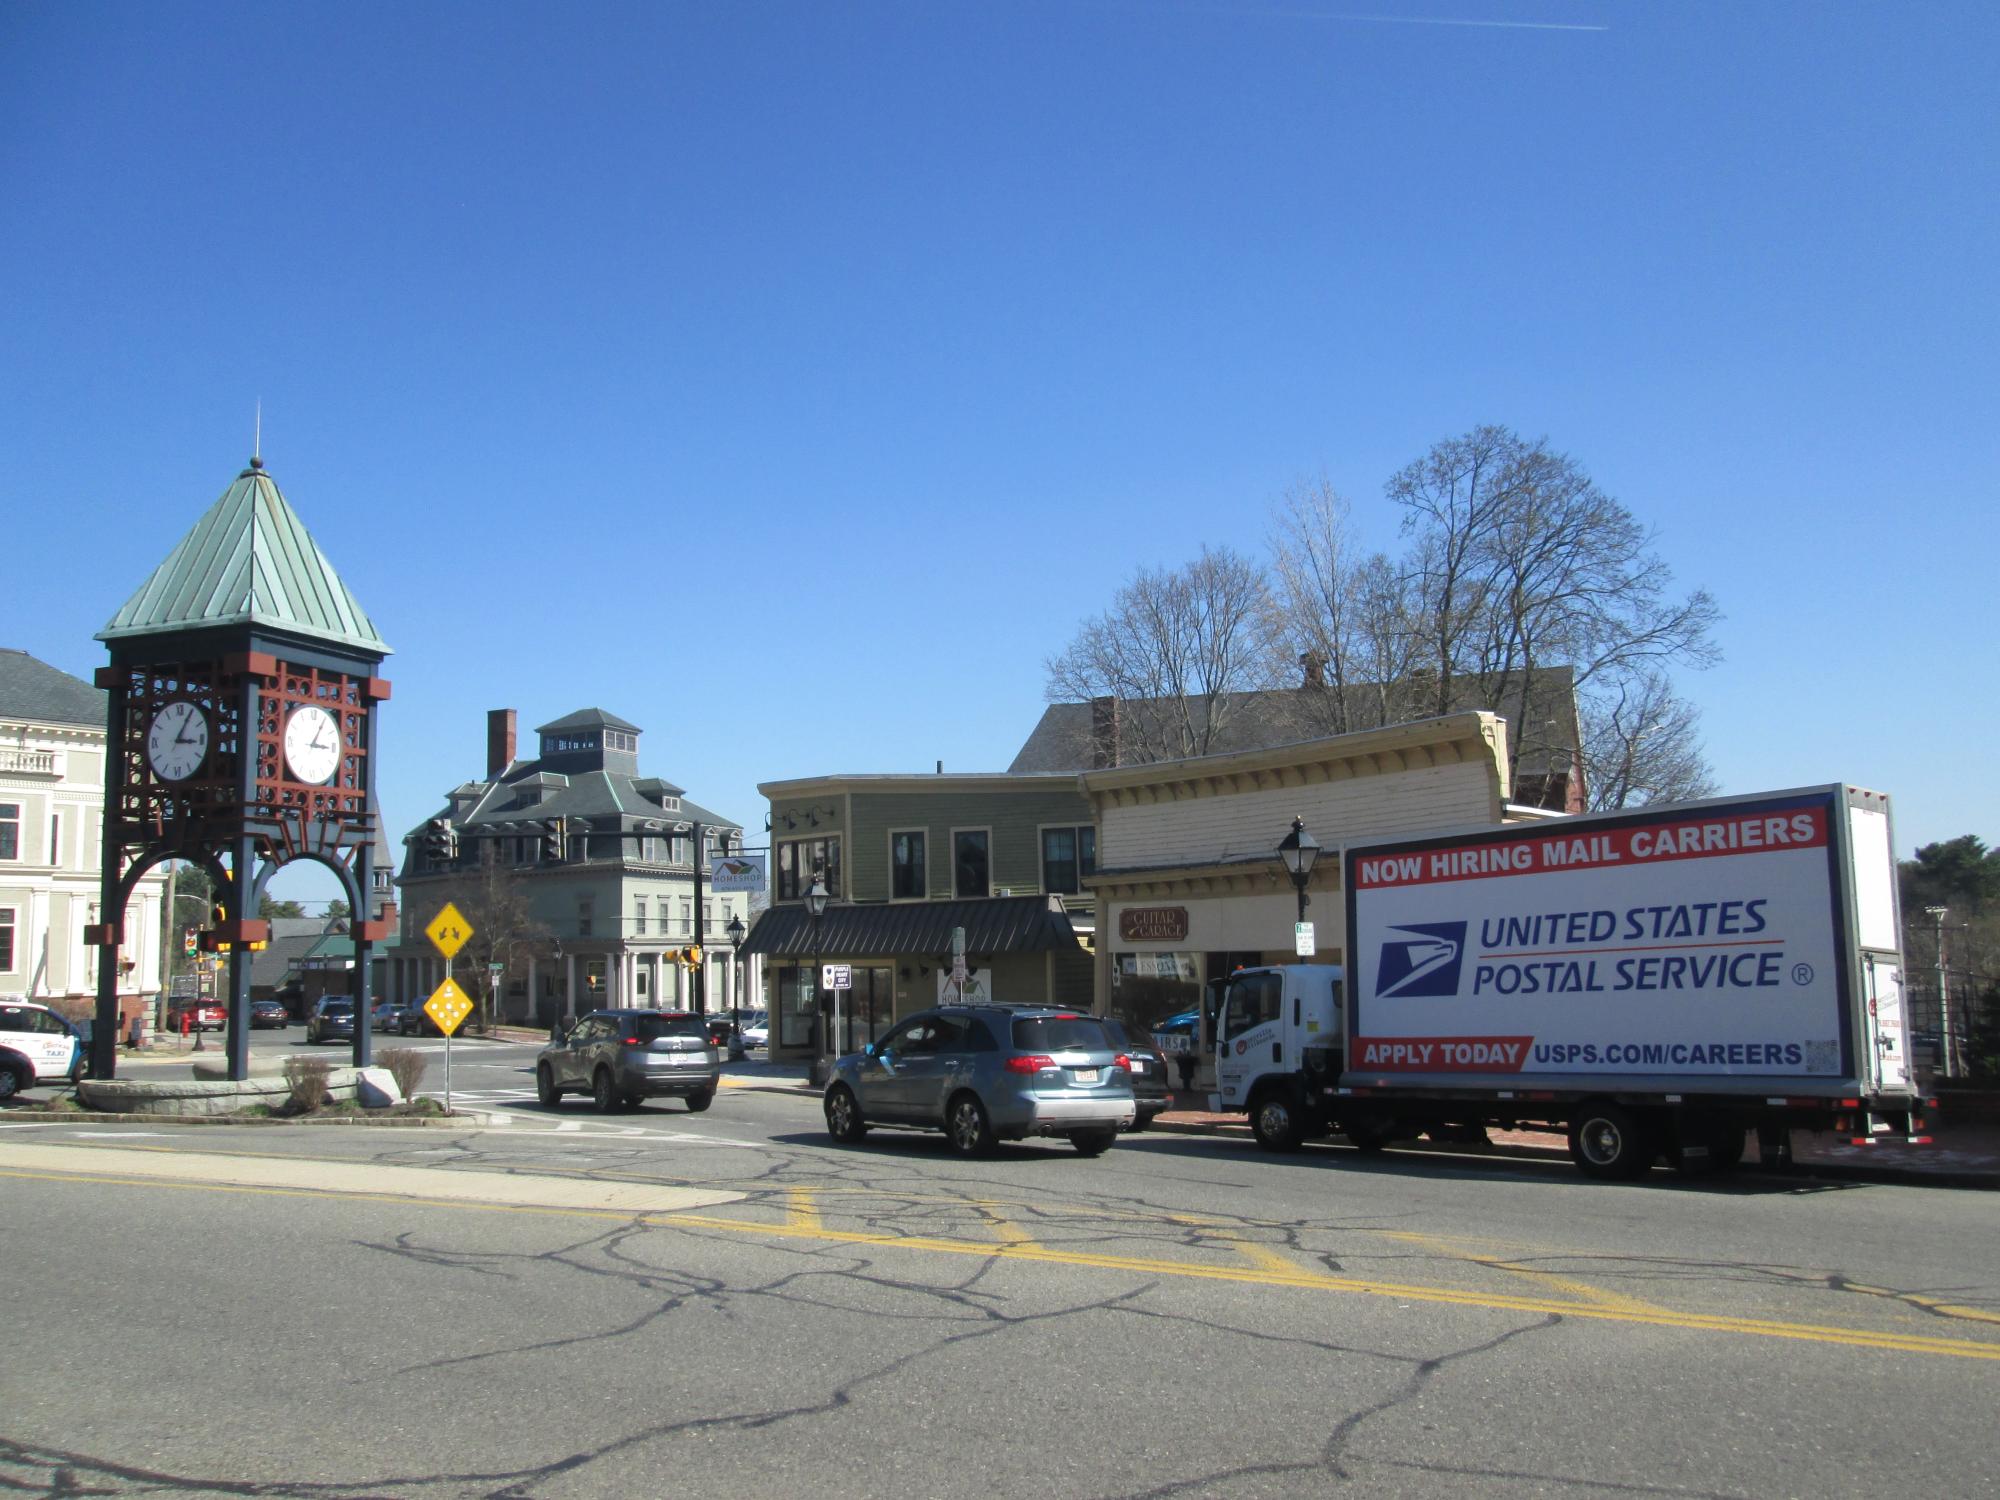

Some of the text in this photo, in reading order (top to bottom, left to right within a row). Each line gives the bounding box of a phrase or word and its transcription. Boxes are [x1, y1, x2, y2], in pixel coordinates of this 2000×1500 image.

[1362, 814, 1815, 884] NOW HIRING MAIL CARRIERS
[714, 873, 762, 883] HOMESHOP
[1133, 911, 1176, 925] GUITAR
[1481, 899, 1768, 949] UNITED STATES
[1140, 923, 1183, 937] GARAGE
[1472, 960, 1605, 996] POSTAL
[1613, 952, 1784, 992] SERVICE
[1363, 1043, 1521, 1065] APPLY TODAY
[1534, 1043, 1803, 1065] USPS.COM/CAREERS
